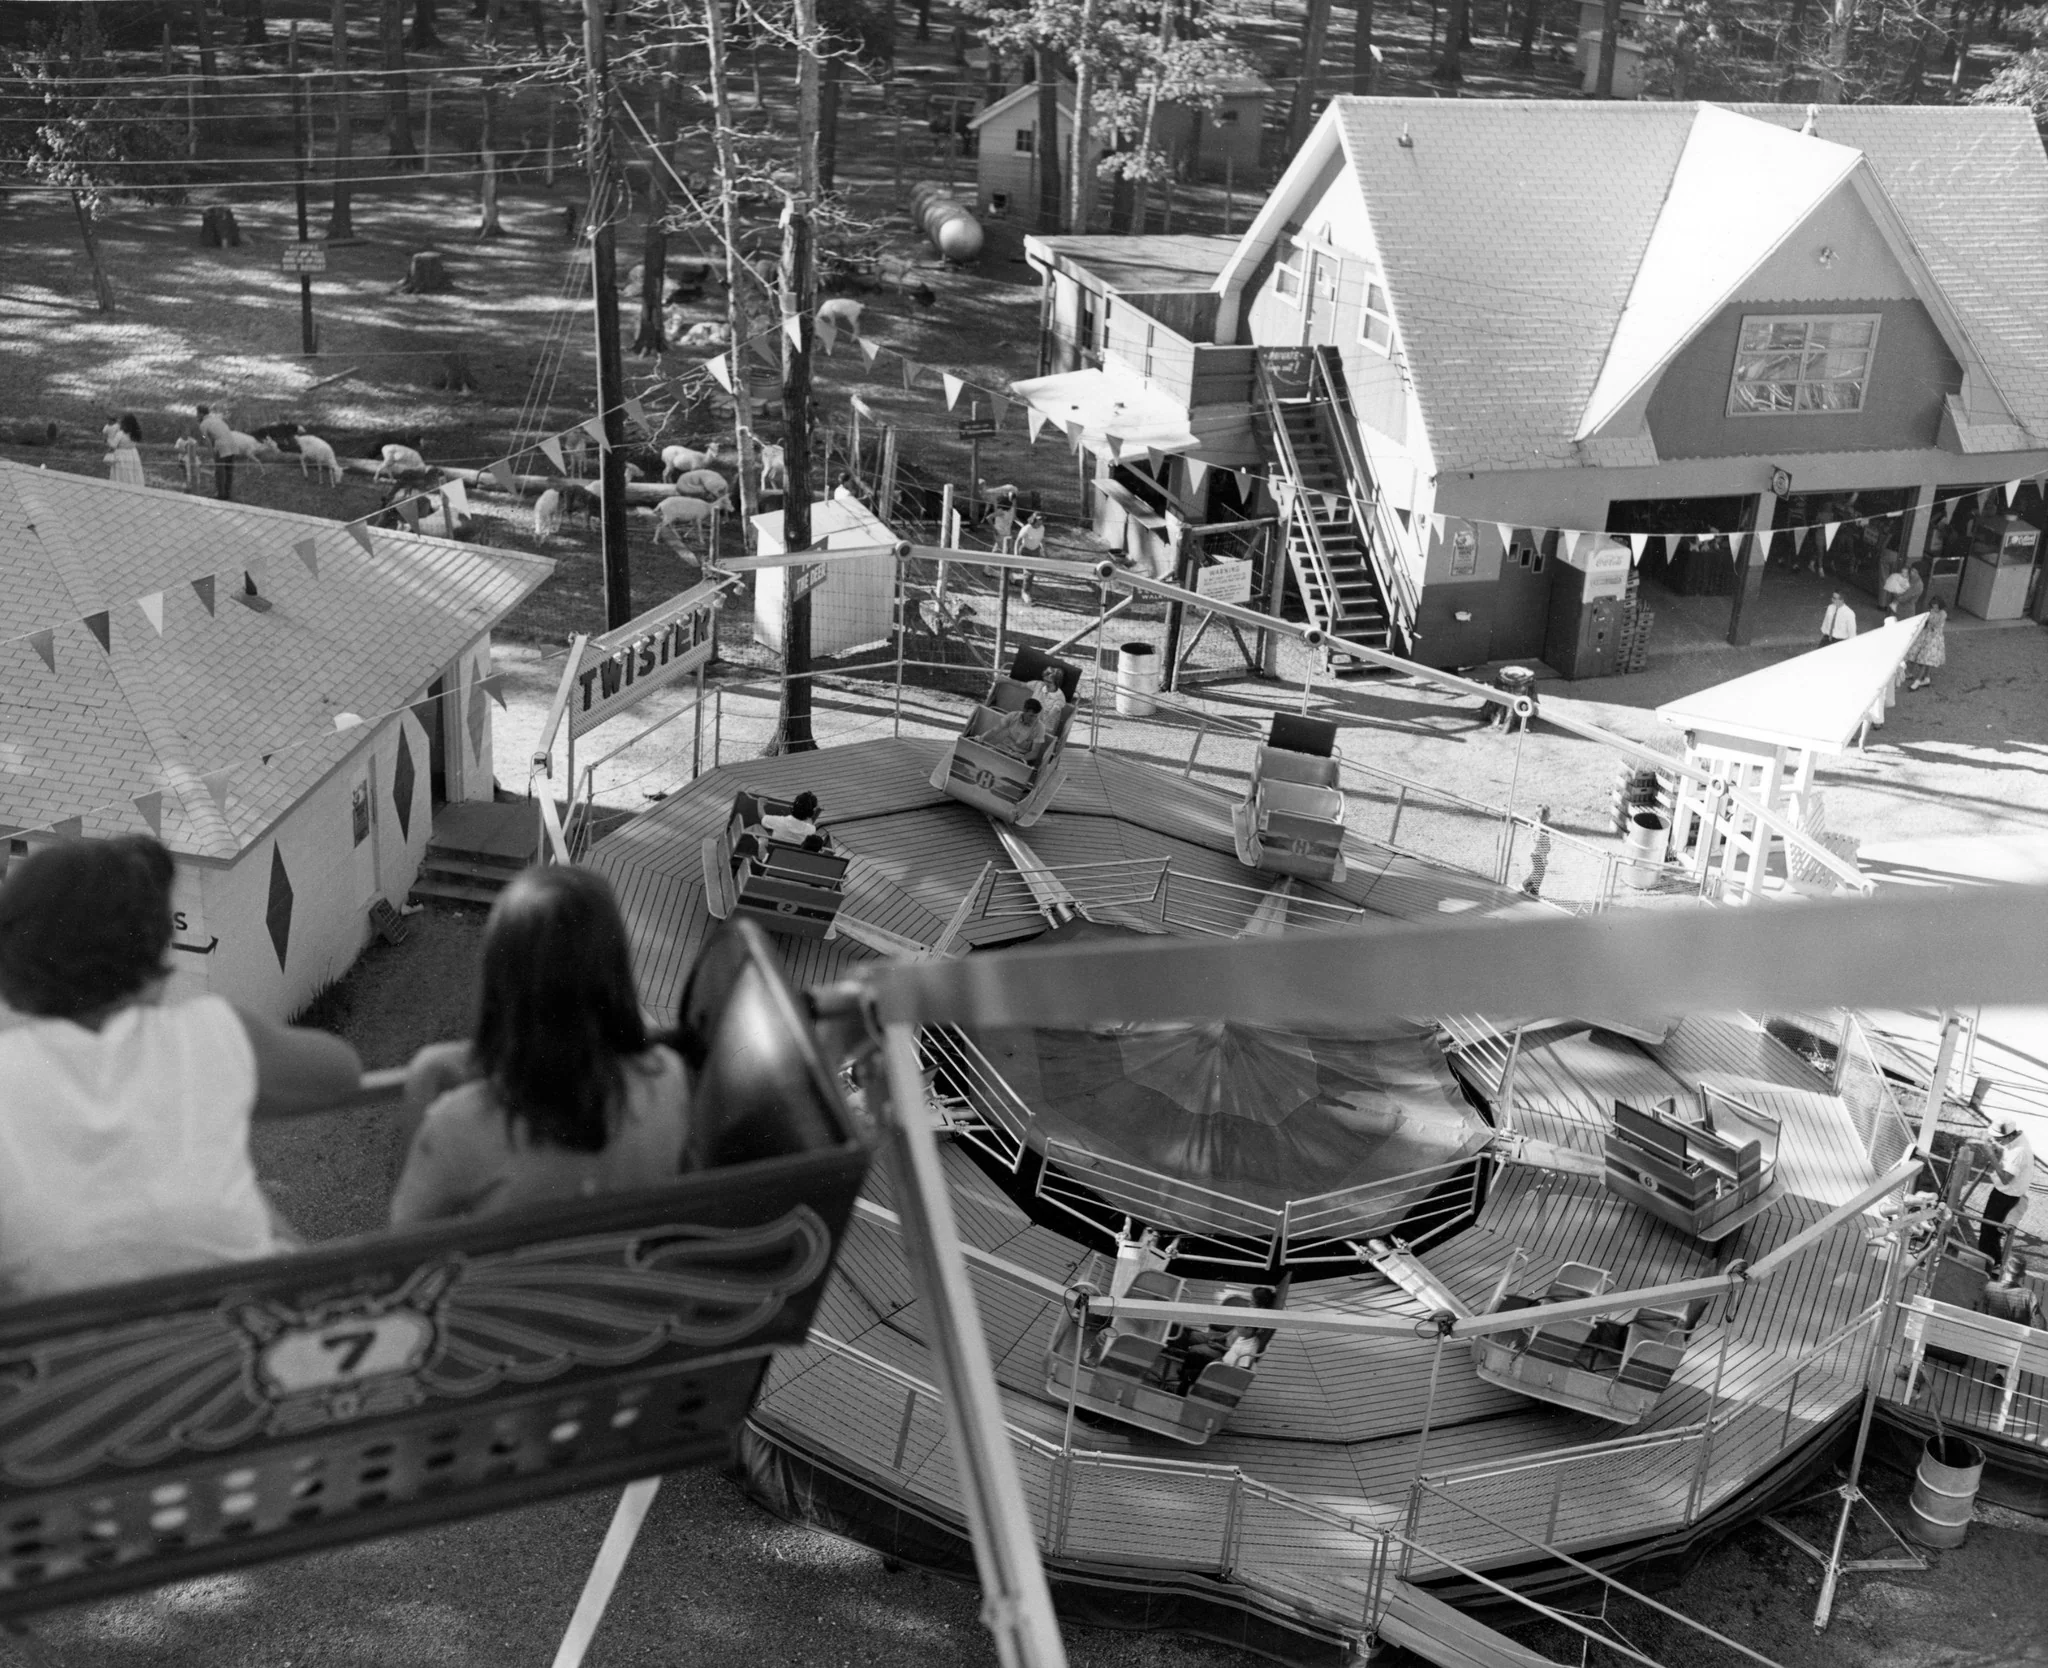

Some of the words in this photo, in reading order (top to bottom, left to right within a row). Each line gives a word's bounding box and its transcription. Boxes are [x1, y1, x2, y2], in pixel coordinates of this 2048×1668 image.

[796, 572, 809, 594] THE
[810, 562, 827, 587] DEER
[1208, 565, 1240, 577] WARNING
[579, 606, 711, 711] TWISTER
[782, 903, 793, 913] 2
[1644, 1176, 1653, 1188] 6
[323, 1329, 377, 1374] 7
